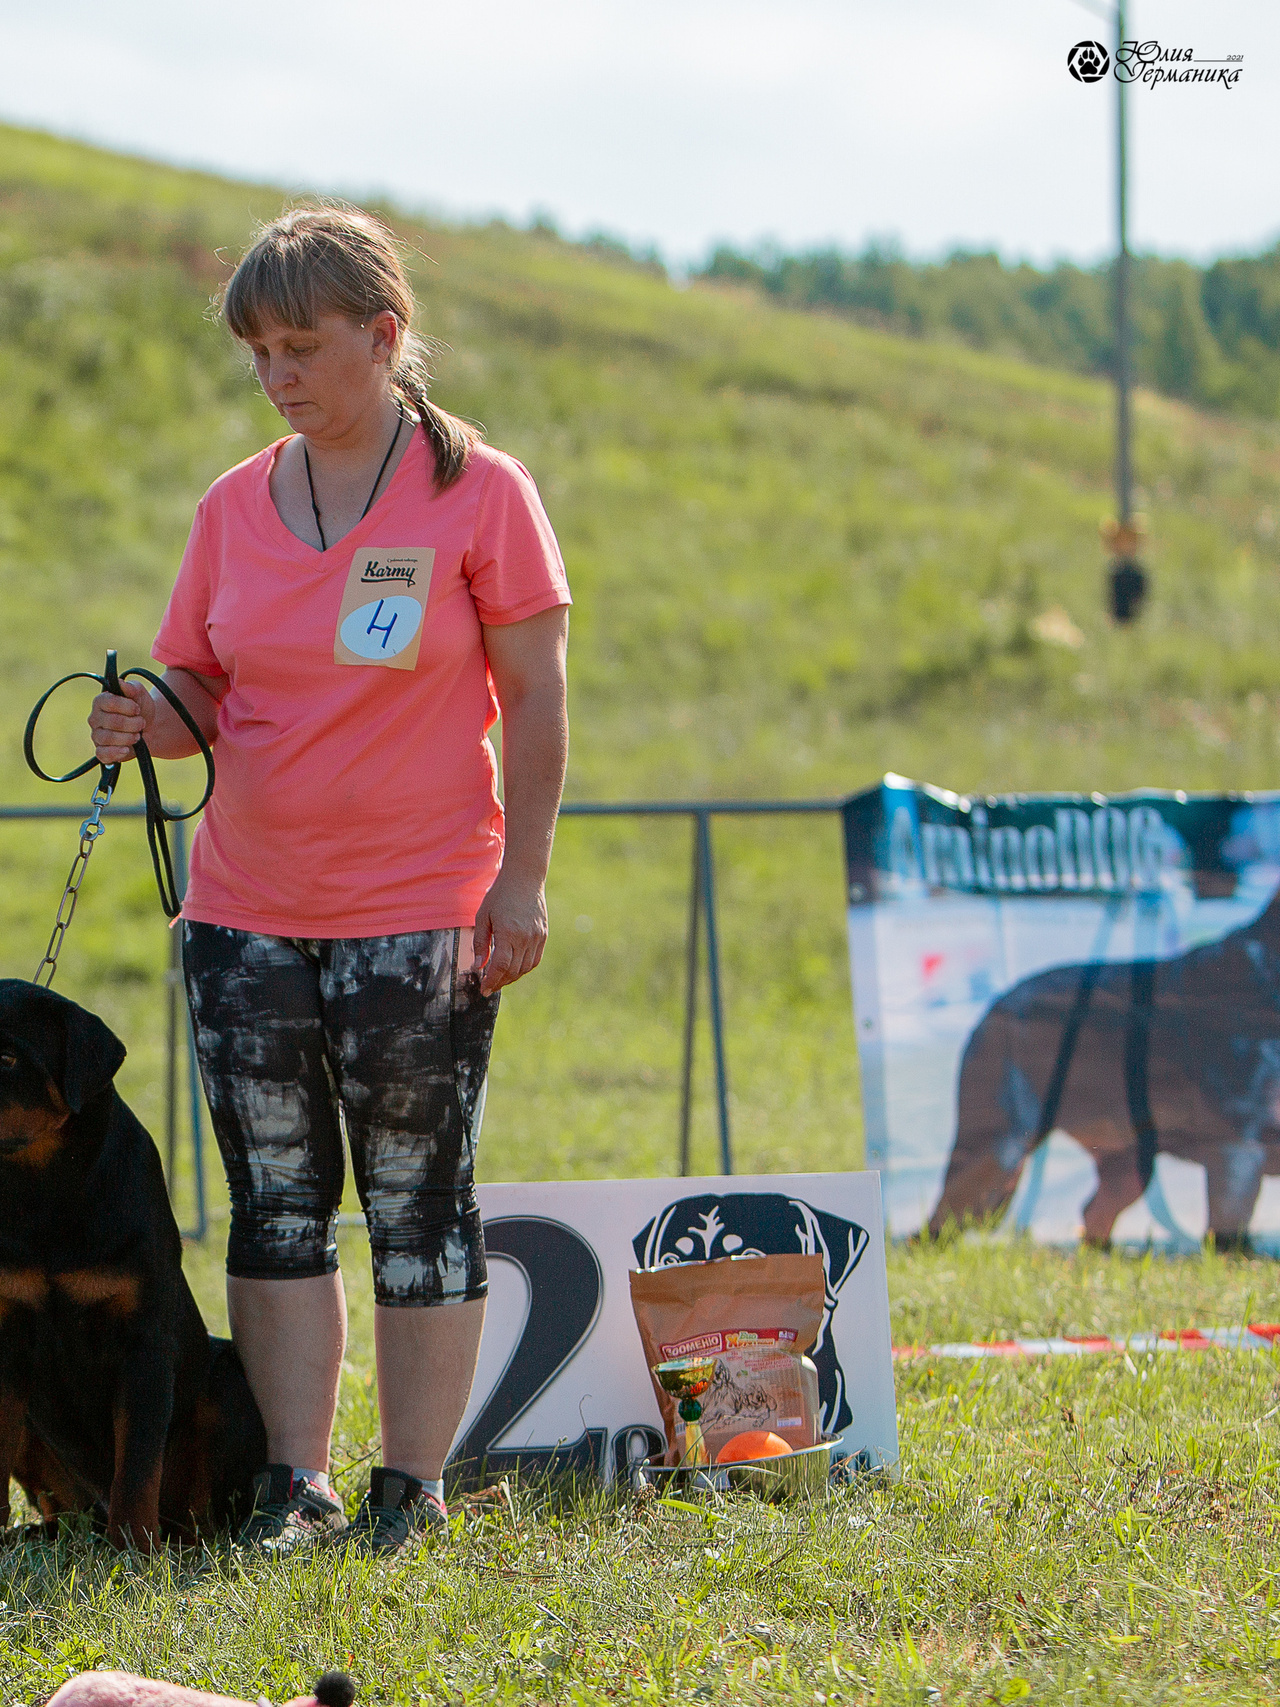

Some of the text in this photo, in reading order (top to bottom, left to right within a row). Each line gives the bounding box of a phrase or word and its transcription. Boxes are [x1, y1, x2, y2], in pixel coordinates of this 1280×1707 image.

[362, 560, 416, 588] Karmy
[366, 598, 398, 649] 4
[665, 1335, 719, 1357] ЗООМЕНЮ
